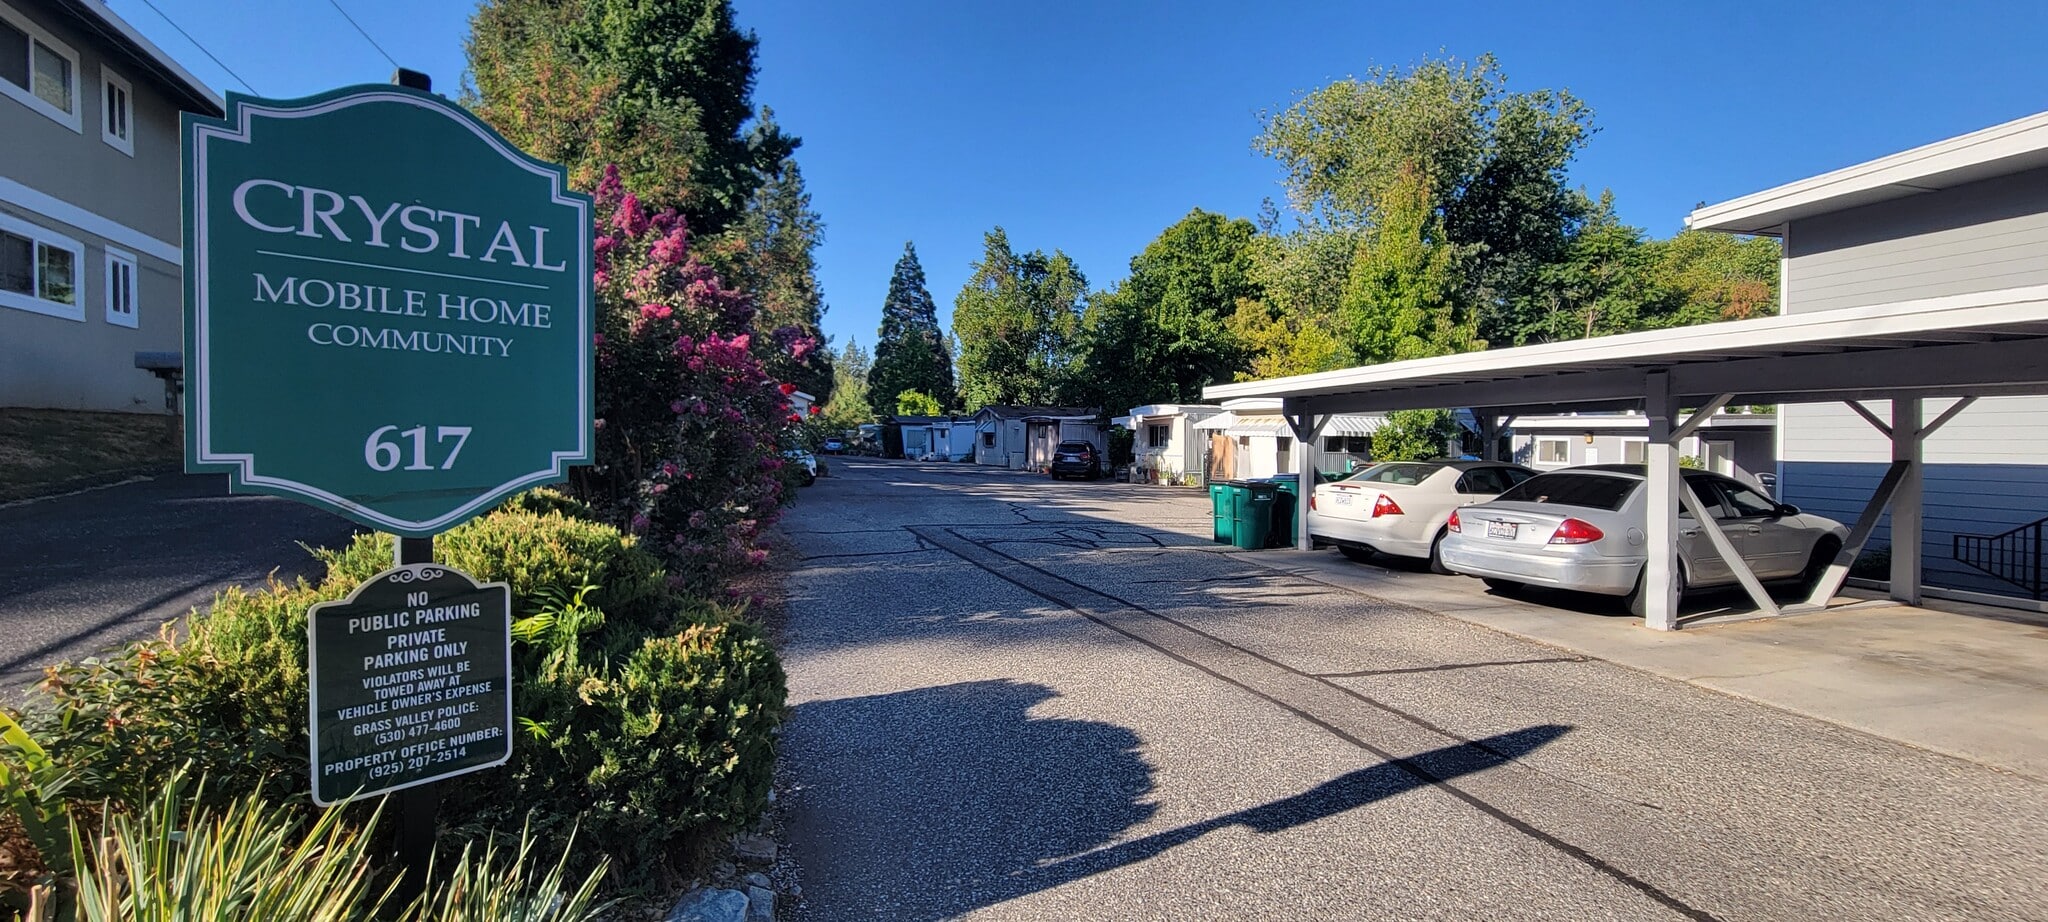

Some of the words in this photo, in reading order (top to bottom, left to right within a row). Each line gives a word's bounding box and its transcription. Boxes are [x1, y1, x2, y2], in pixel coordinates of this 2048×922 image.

[232, 179, 566, 273] CRYSTAL
[252, 273, 427, 317] MOBILE
[438, 294, 551, 328] HOME
[308, 323, 514, 357] COMMUNITY
[364, 425, 472, 471] 617
[407, 591, 428, 607] NO
[349, 611, 409, 634] PUBLIC
[416, 603, 480, 624] PARKING
[388, 628, 446, 649] PRIVATE
[364, 648, 428, 670] PARKING
[434, 641, 468, 658] ONLY
[362, 669, 424, 689] VIOLATORS
[428, 664, 454, 677] WILL
[457, 661, 470, 672] BE
[374, 685, 413, 700] TOWED
[417, 678, 446, 692] AWAY
[449, 675, 461, 686] AT
[338, 702, 387, 720] VEHICLE
[392, 691, 442, 710] OWNER'S
[446, 681, 492, 700] EXPENSE
[353, 719, 391, 736] GRASS
[395, 710, 434, 727] VALLEY
[438, 702, 479, 717] POLICE:
[375, 729, 405, 746] (530)
[408, 717, 460, 737] 477-4600
[325, 751, 396, 776] PROPERTY
[401, 739, 445, 758] OFFICE
[450, 727, 503, 746] NUMBER:
[369, 762, 404, 779] (925)
[408, 747, 466, 769] 207-2514
